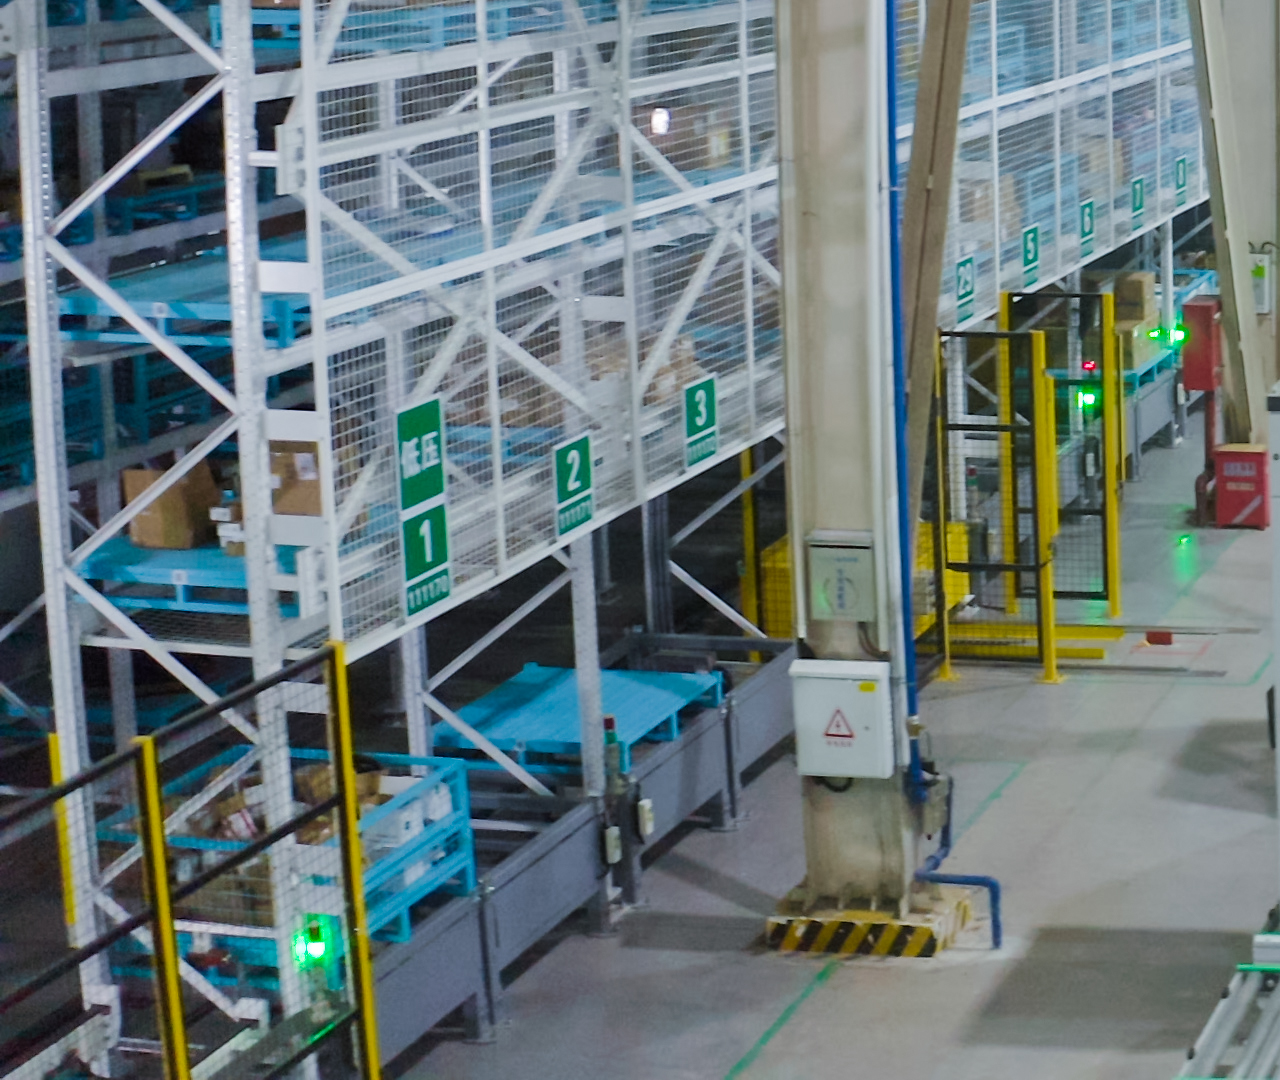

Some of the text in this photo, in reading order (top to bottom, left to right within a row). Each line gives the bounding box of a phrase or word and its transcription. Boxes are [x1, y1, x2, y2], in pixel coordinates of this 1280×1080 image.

[1026, 232, 1035, 260] 5
[694, 389, 707, 427] 3
[401, 431, 440, 479] 低压
[566, 449, 581, 492] 2
[419, 519, 434, 563] 1
